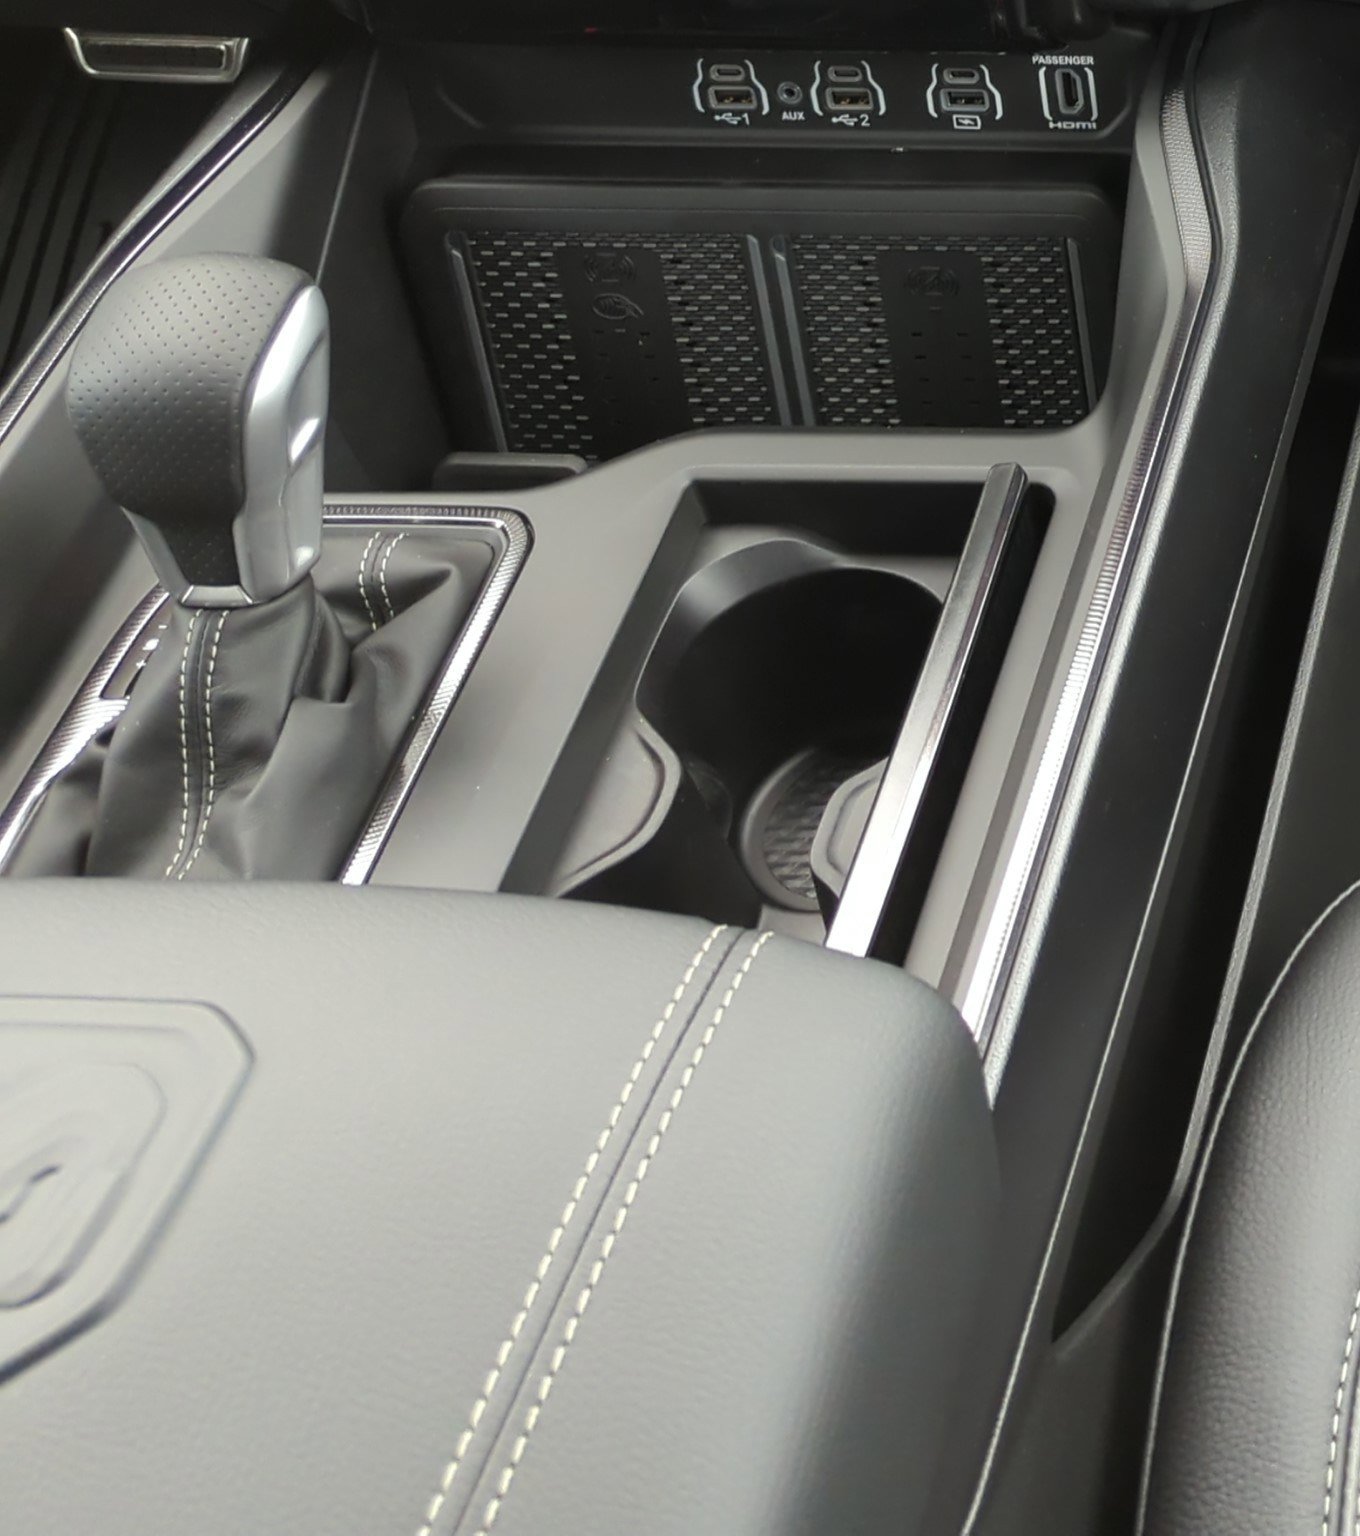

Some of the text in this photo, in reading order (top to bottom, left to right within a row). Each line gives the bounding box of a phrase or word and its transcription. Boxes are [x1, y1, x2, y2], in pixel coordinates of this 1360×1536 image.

[1031, 54, 1095, 66] PASSENGER
[781, 110, 805, 121] AUX
[860, 114, 871, 127] 2
